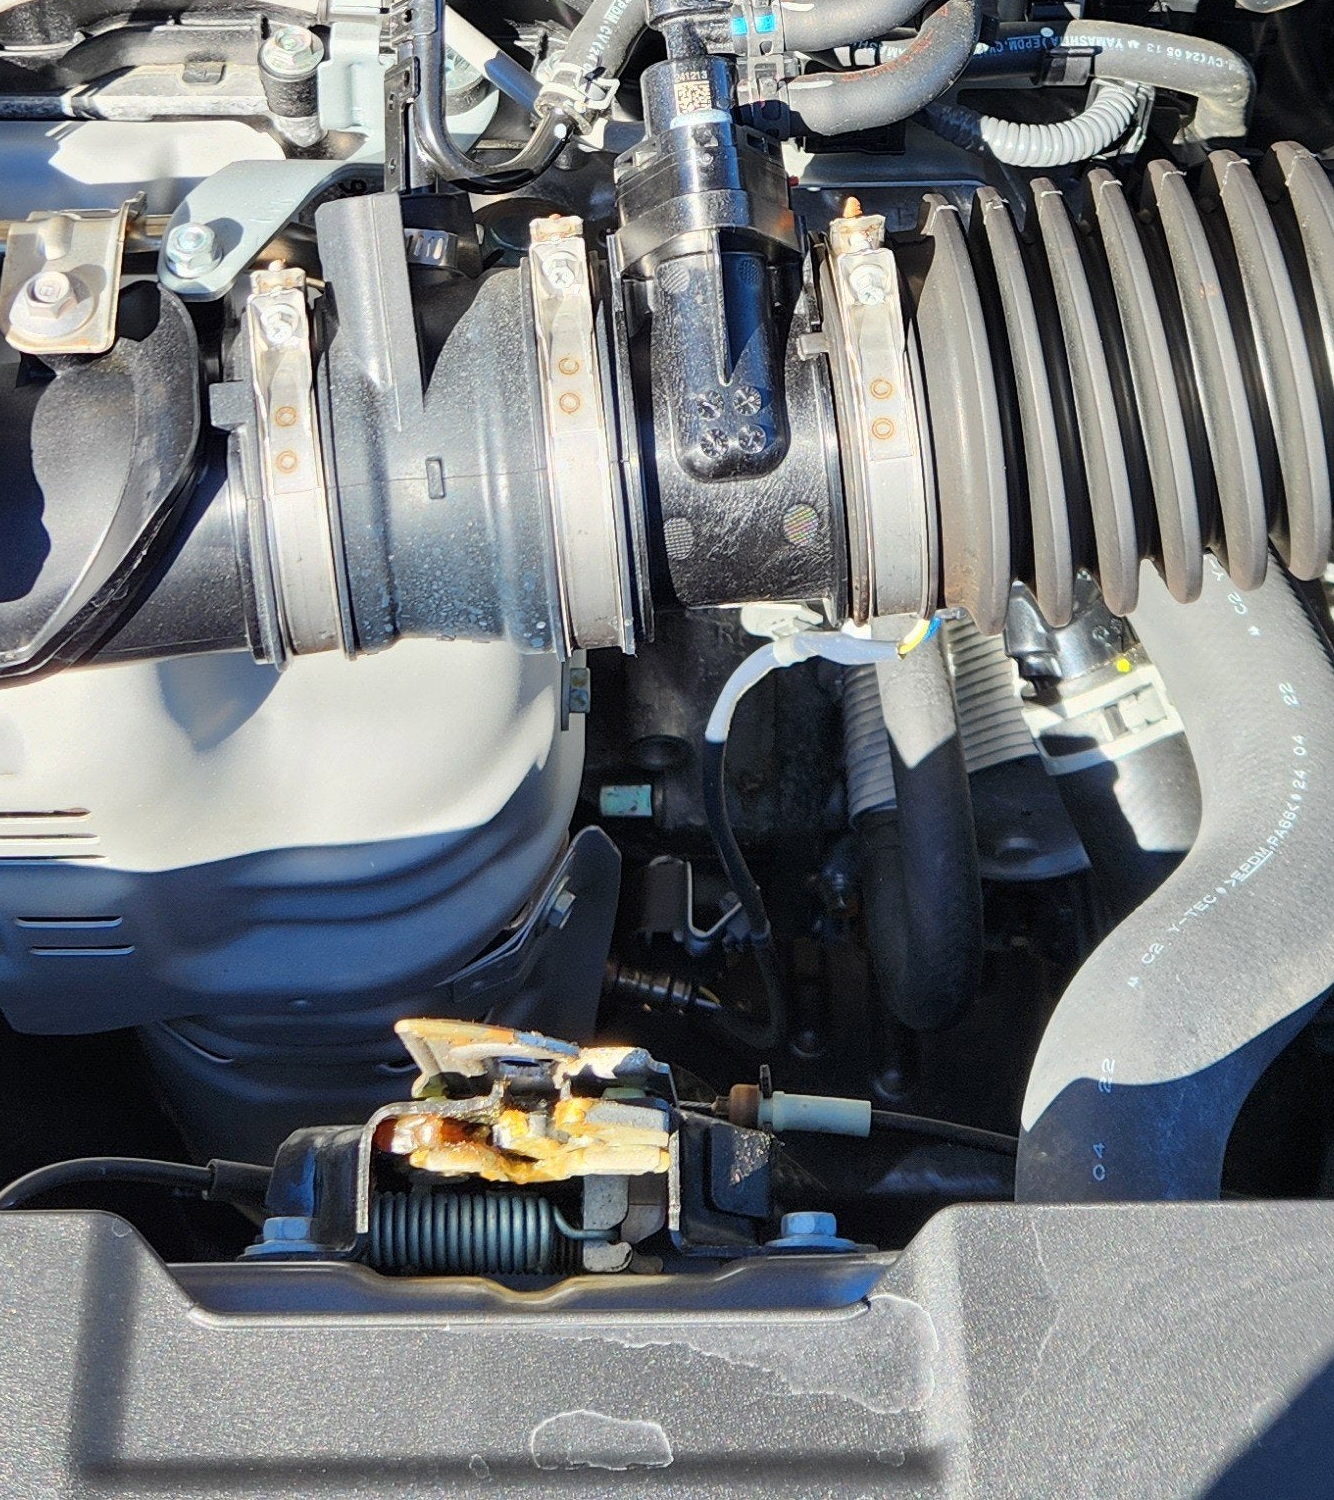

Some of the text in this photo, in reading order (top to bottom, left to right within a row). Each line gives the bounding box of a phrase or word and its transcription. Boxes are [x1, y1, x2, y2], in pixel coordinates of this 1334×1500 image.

[1226, 591, 1249, 617] C2
[1278, 681, 1301, 708] 22
[1292, 733, 1308, 757] 04
[1292, 768, 1308, 791] 24
[1167, 893, 1218, 935] Y-TEC
[1141, 941, 1165, 965] C2
[1097, 1057, 1116, 1095] 22
[1091, 1141, 1107, 1182] 04
